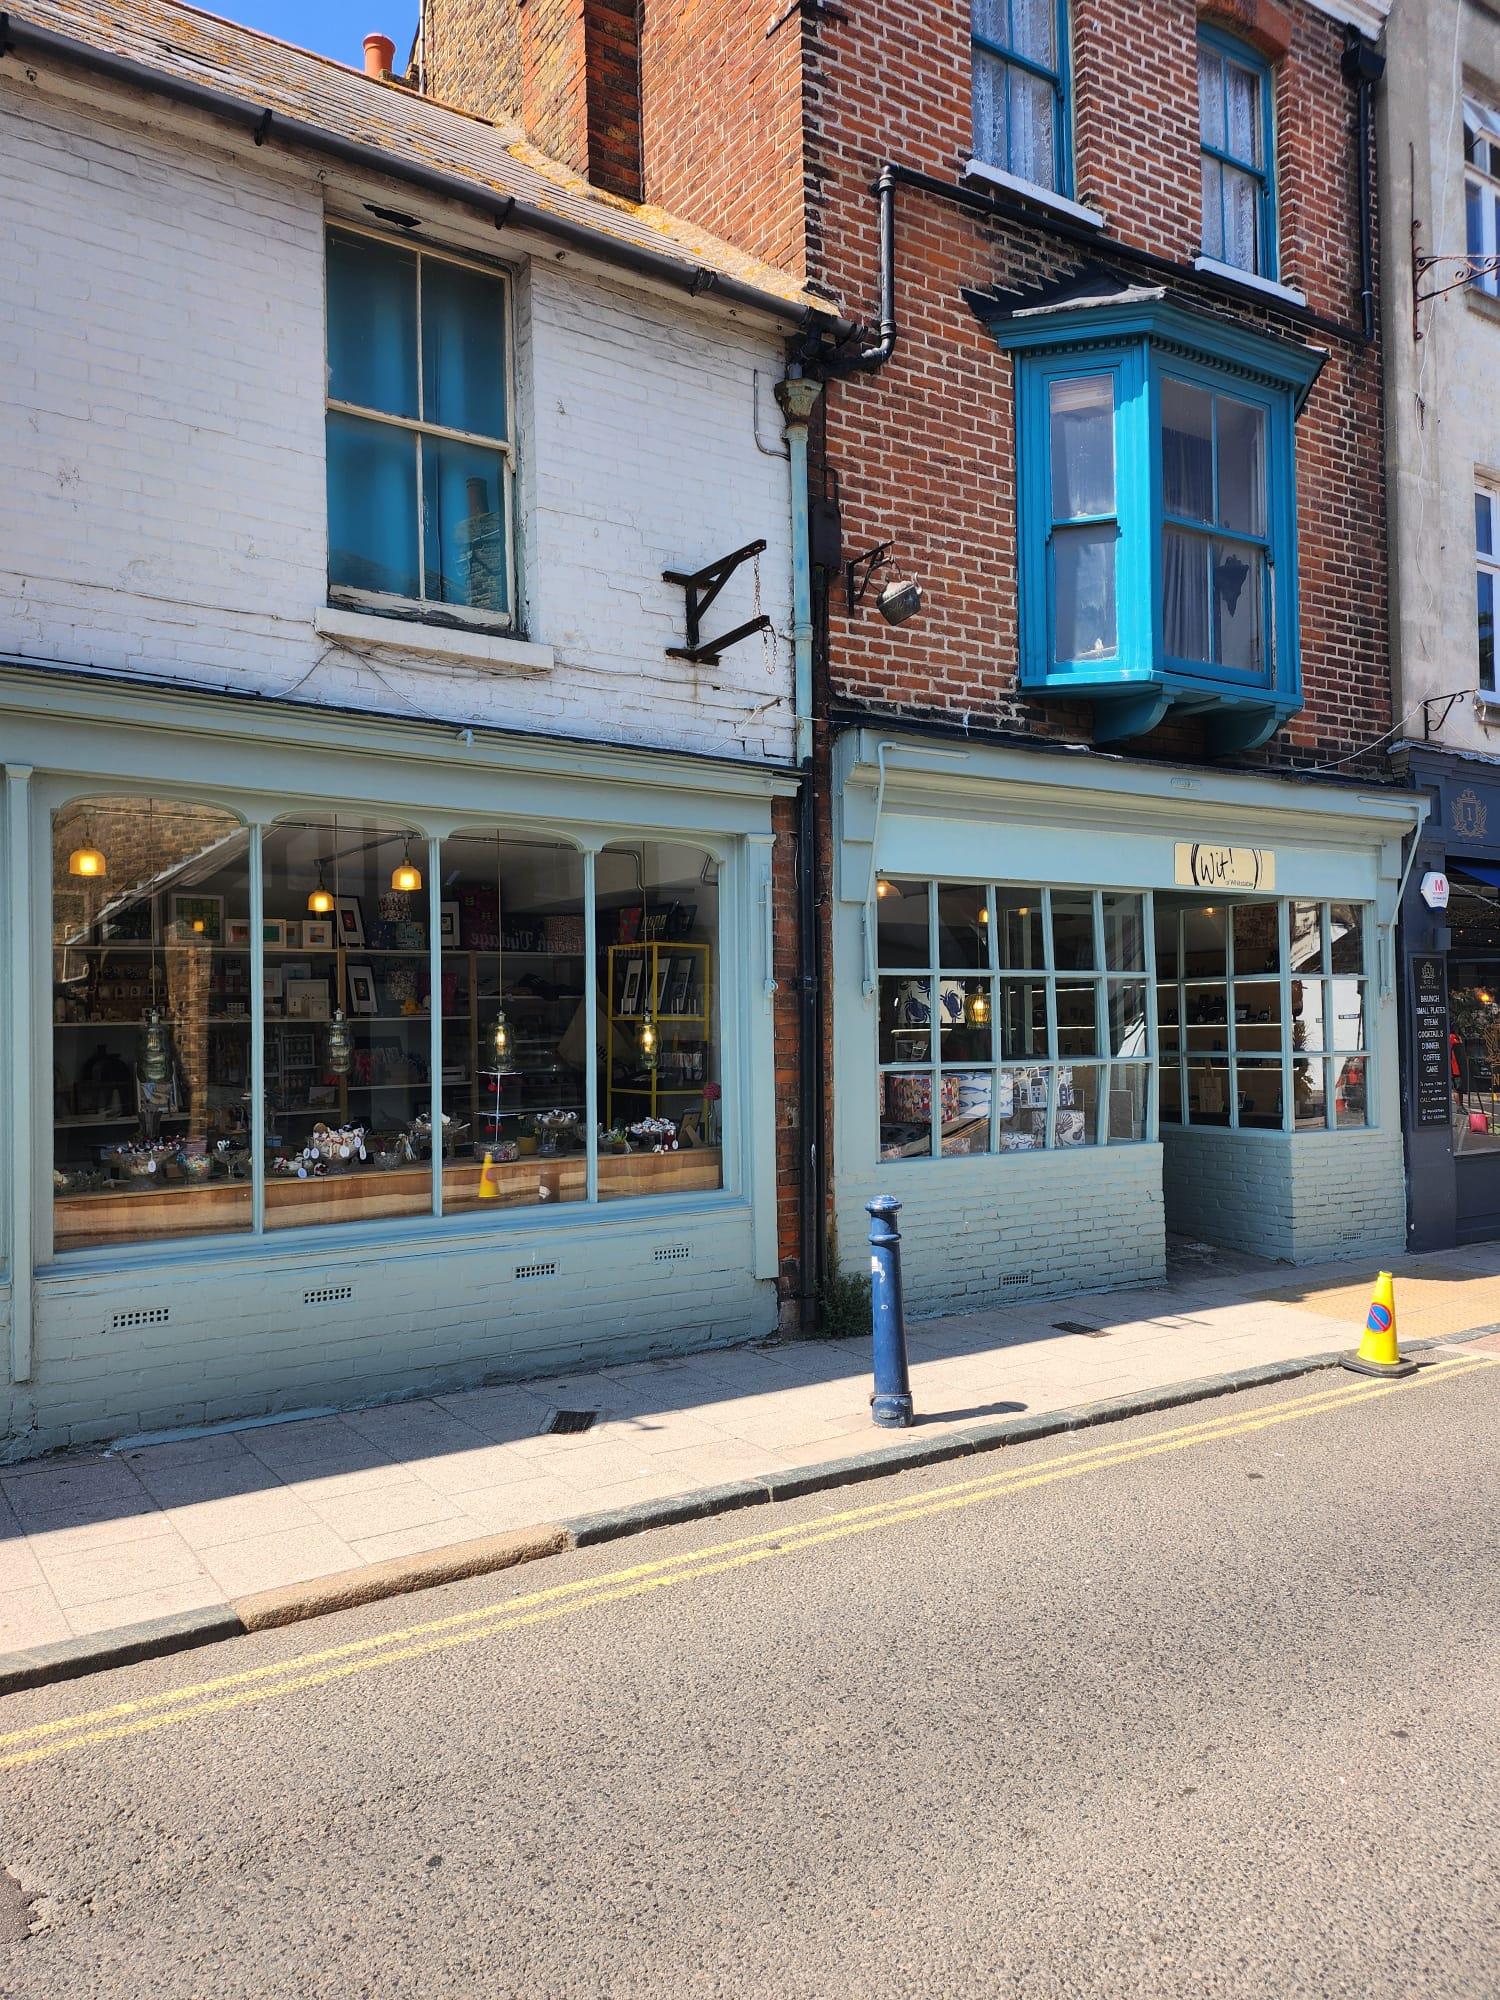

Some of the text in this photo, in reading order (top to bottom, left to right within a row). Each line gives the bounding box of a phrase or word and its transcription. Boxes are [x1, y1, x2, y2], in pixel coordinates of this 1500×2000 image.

[1420, 995, 1440, 1003] BRUNCH
[1416, 1006, 1446, 1015] SMALL PLATES
[1423, 1018, 1439, 1026] STEAK
[1417, 1030, 1444, 1039] COCKTAILS
[1422, 1053, 1441, 1061] COFFEE
